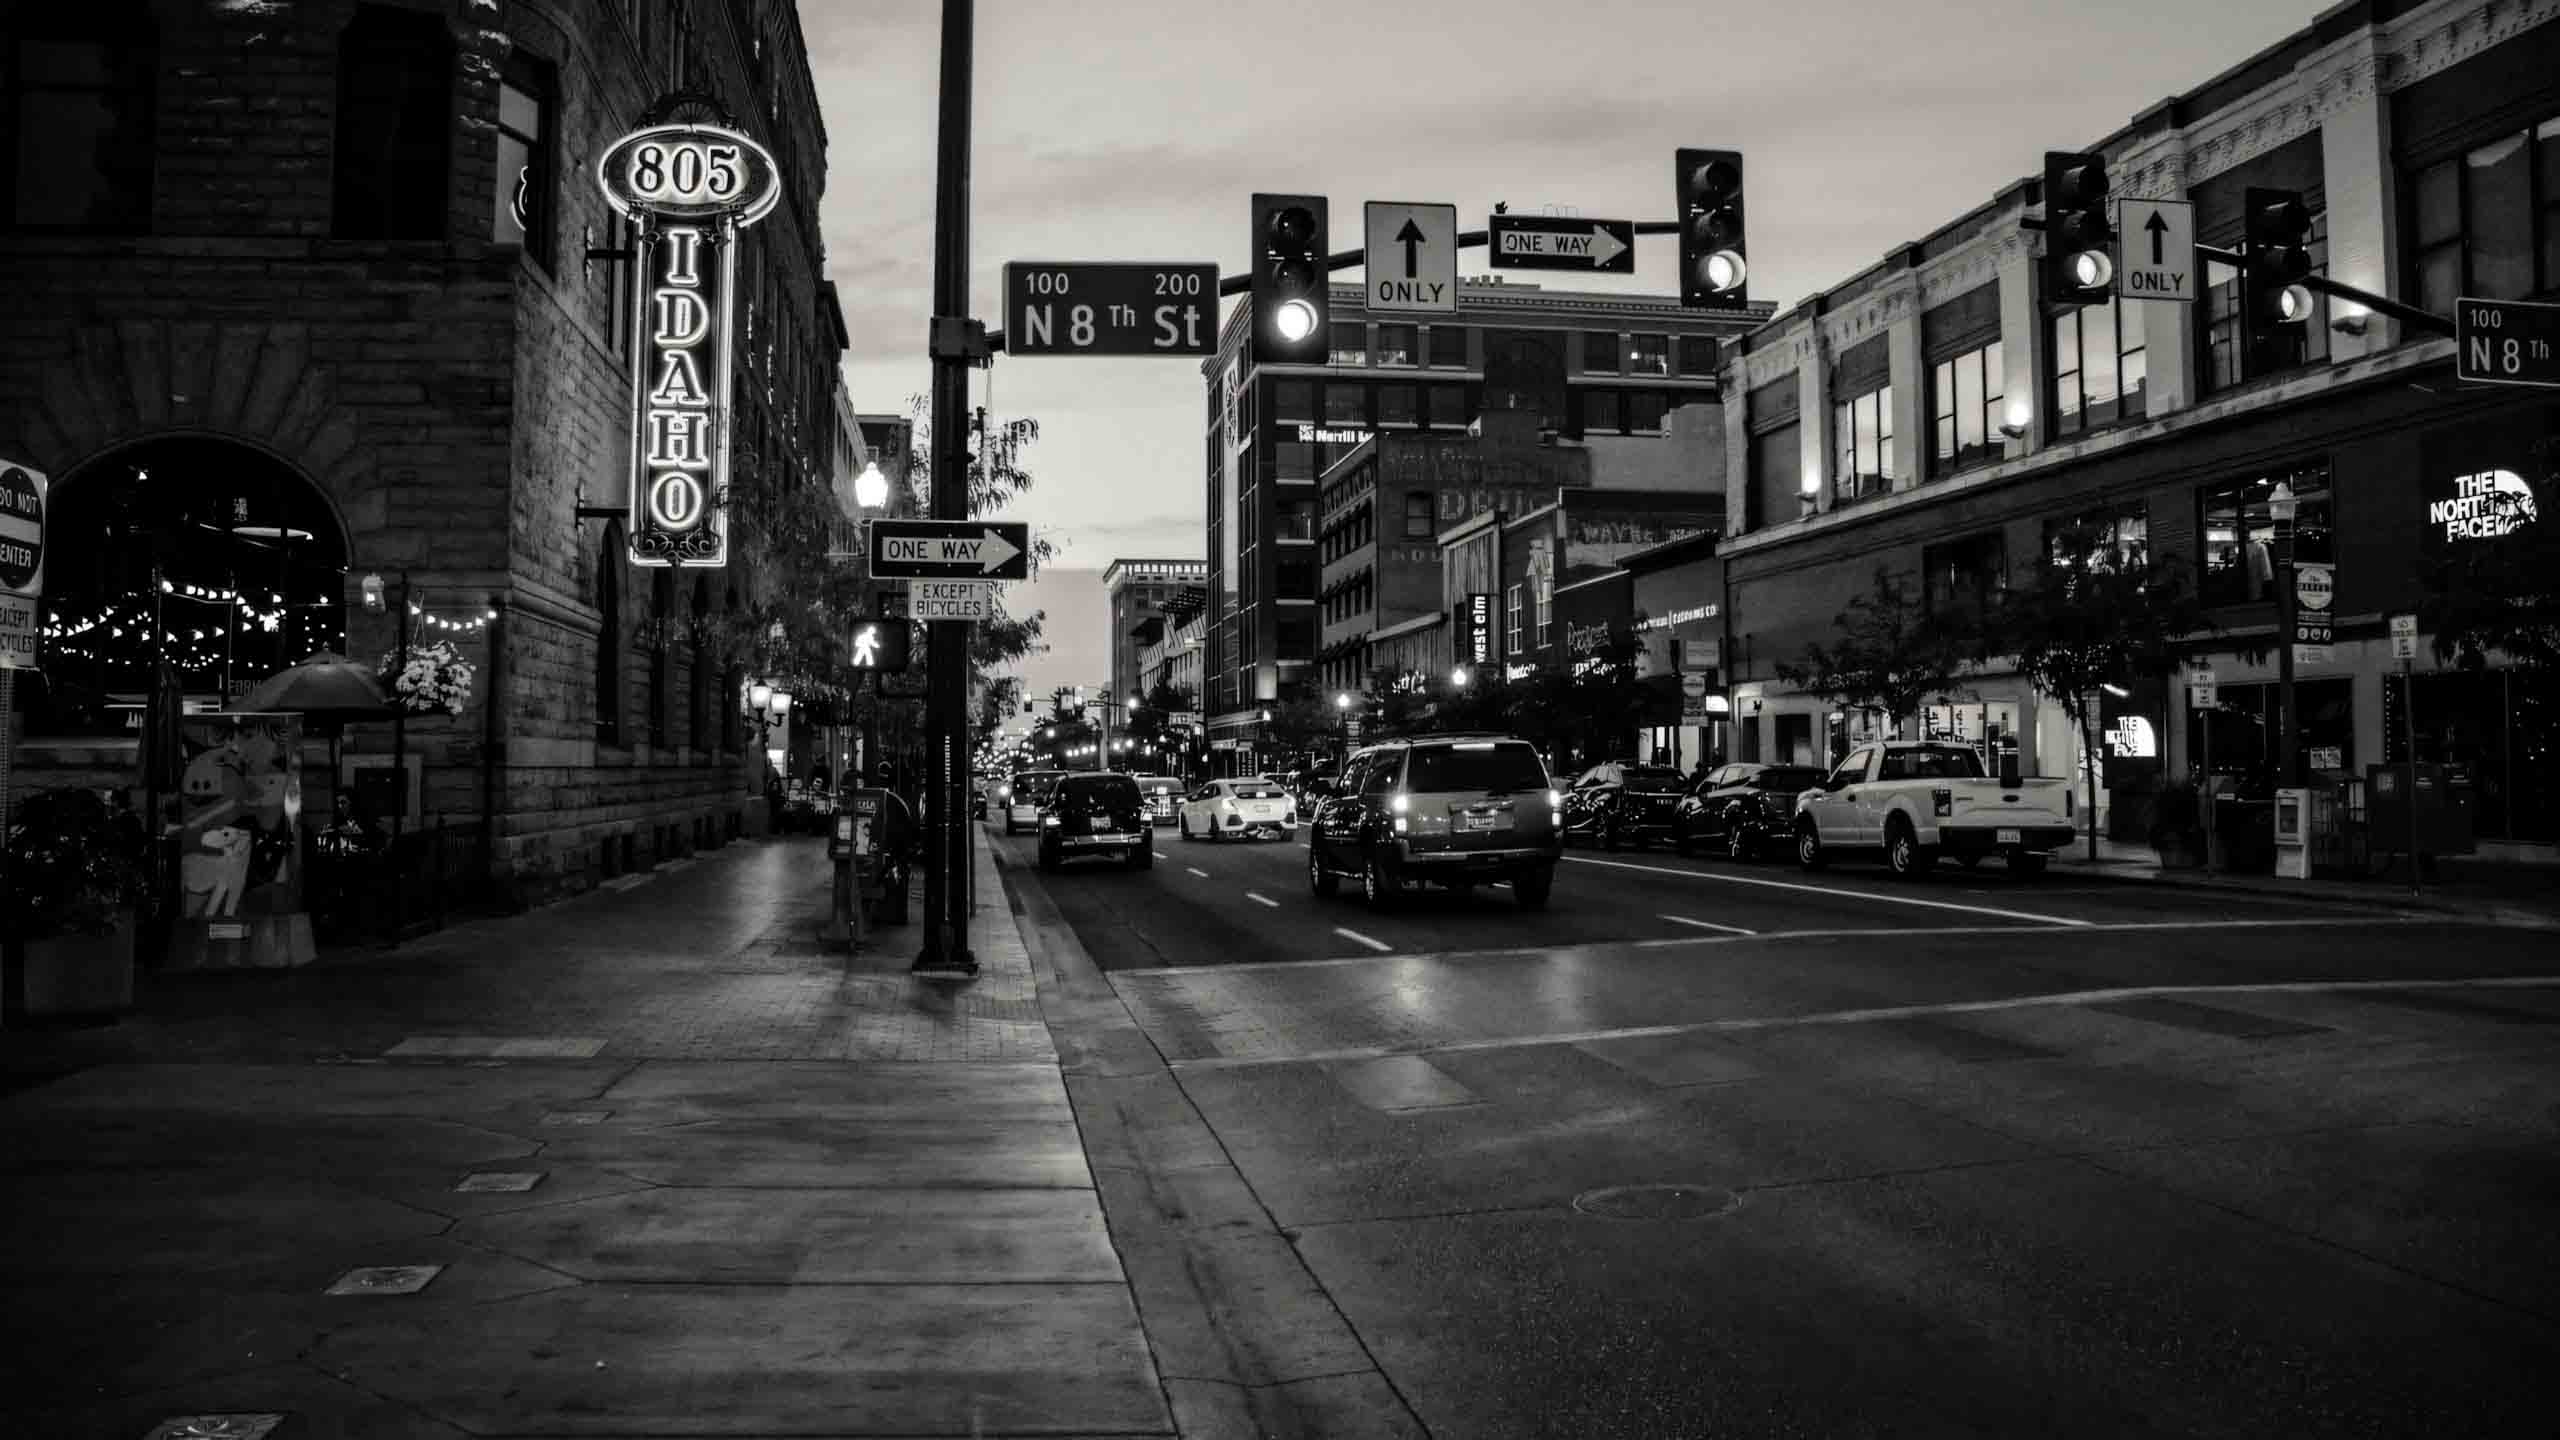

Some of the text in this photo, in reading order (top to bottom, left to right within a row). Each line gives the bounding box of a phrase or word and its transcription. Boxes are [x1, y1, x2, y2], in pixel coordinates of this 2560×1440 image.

[633, 144, 738, 195] 805
[1505, 233, 1593, 254] ONE WAY
[1025, 272, 1201, 296] 100 200
[1379, 280, 1444, 303] ONLY
[2130, 271, 2184, 291] ONLY
[1024, 304, 1053, 346] N
[1070, 304, 1096, 346] 8
[1153, 304, 1201, 347] St
[2470, 309, 2502, 328] 100
[2471, 336, 2491, 372] N
[2503, 338, 2520, 374] 8
[649, 228, 712, 530] IDAHO
[2454, 471, 2494, 499] THE
[2446, 515, 2496, 543] FACE
[889, 541, 982, 559] ONE WAY
[923, 584, 975, 599] EXCEPT
[917, 601, 981, 616] BICYCLES
[1472, 596, 1486, 625] elm
